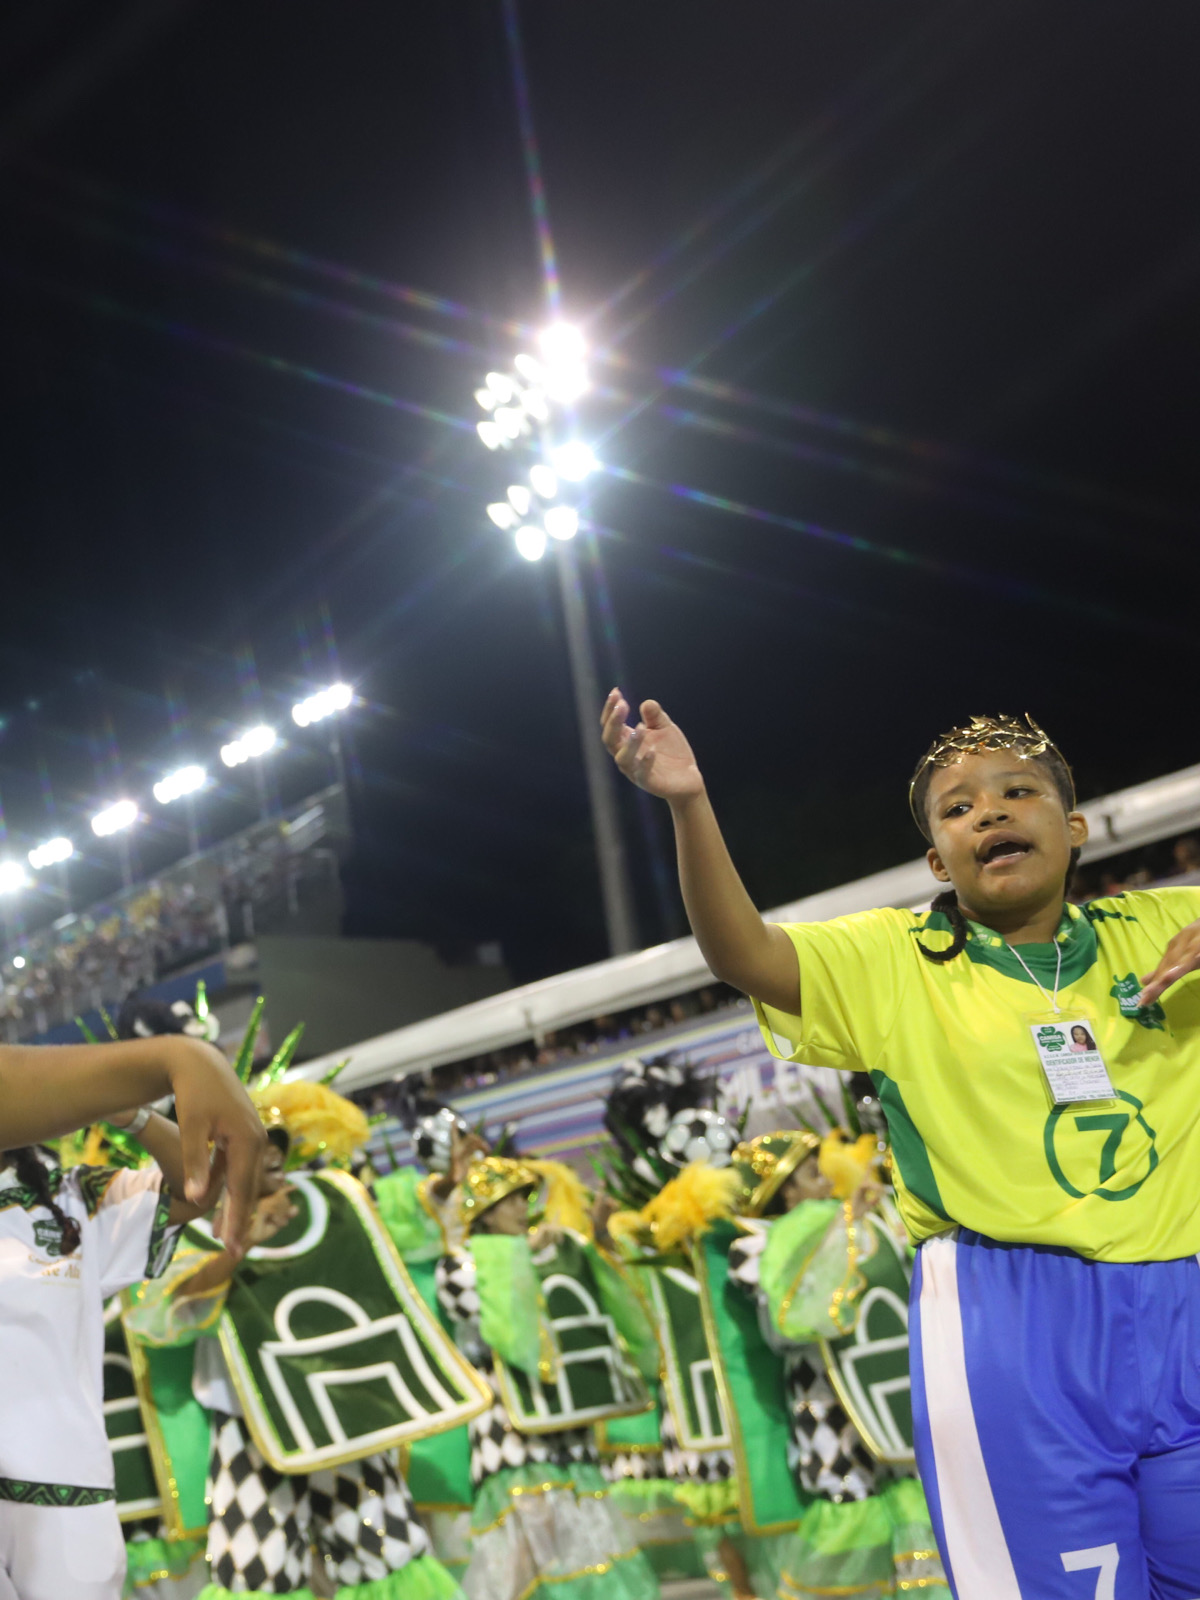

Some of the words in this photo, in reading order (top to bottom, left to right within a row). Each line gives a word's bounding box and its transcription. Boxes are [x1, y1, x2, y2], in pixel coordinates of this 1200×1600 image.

[1046, 1058, 1077, 1066] IDENTIFICADOR
[1074, 1113, 1130, 1185] 7
[1060, 1542, 1120, 1600] 7
